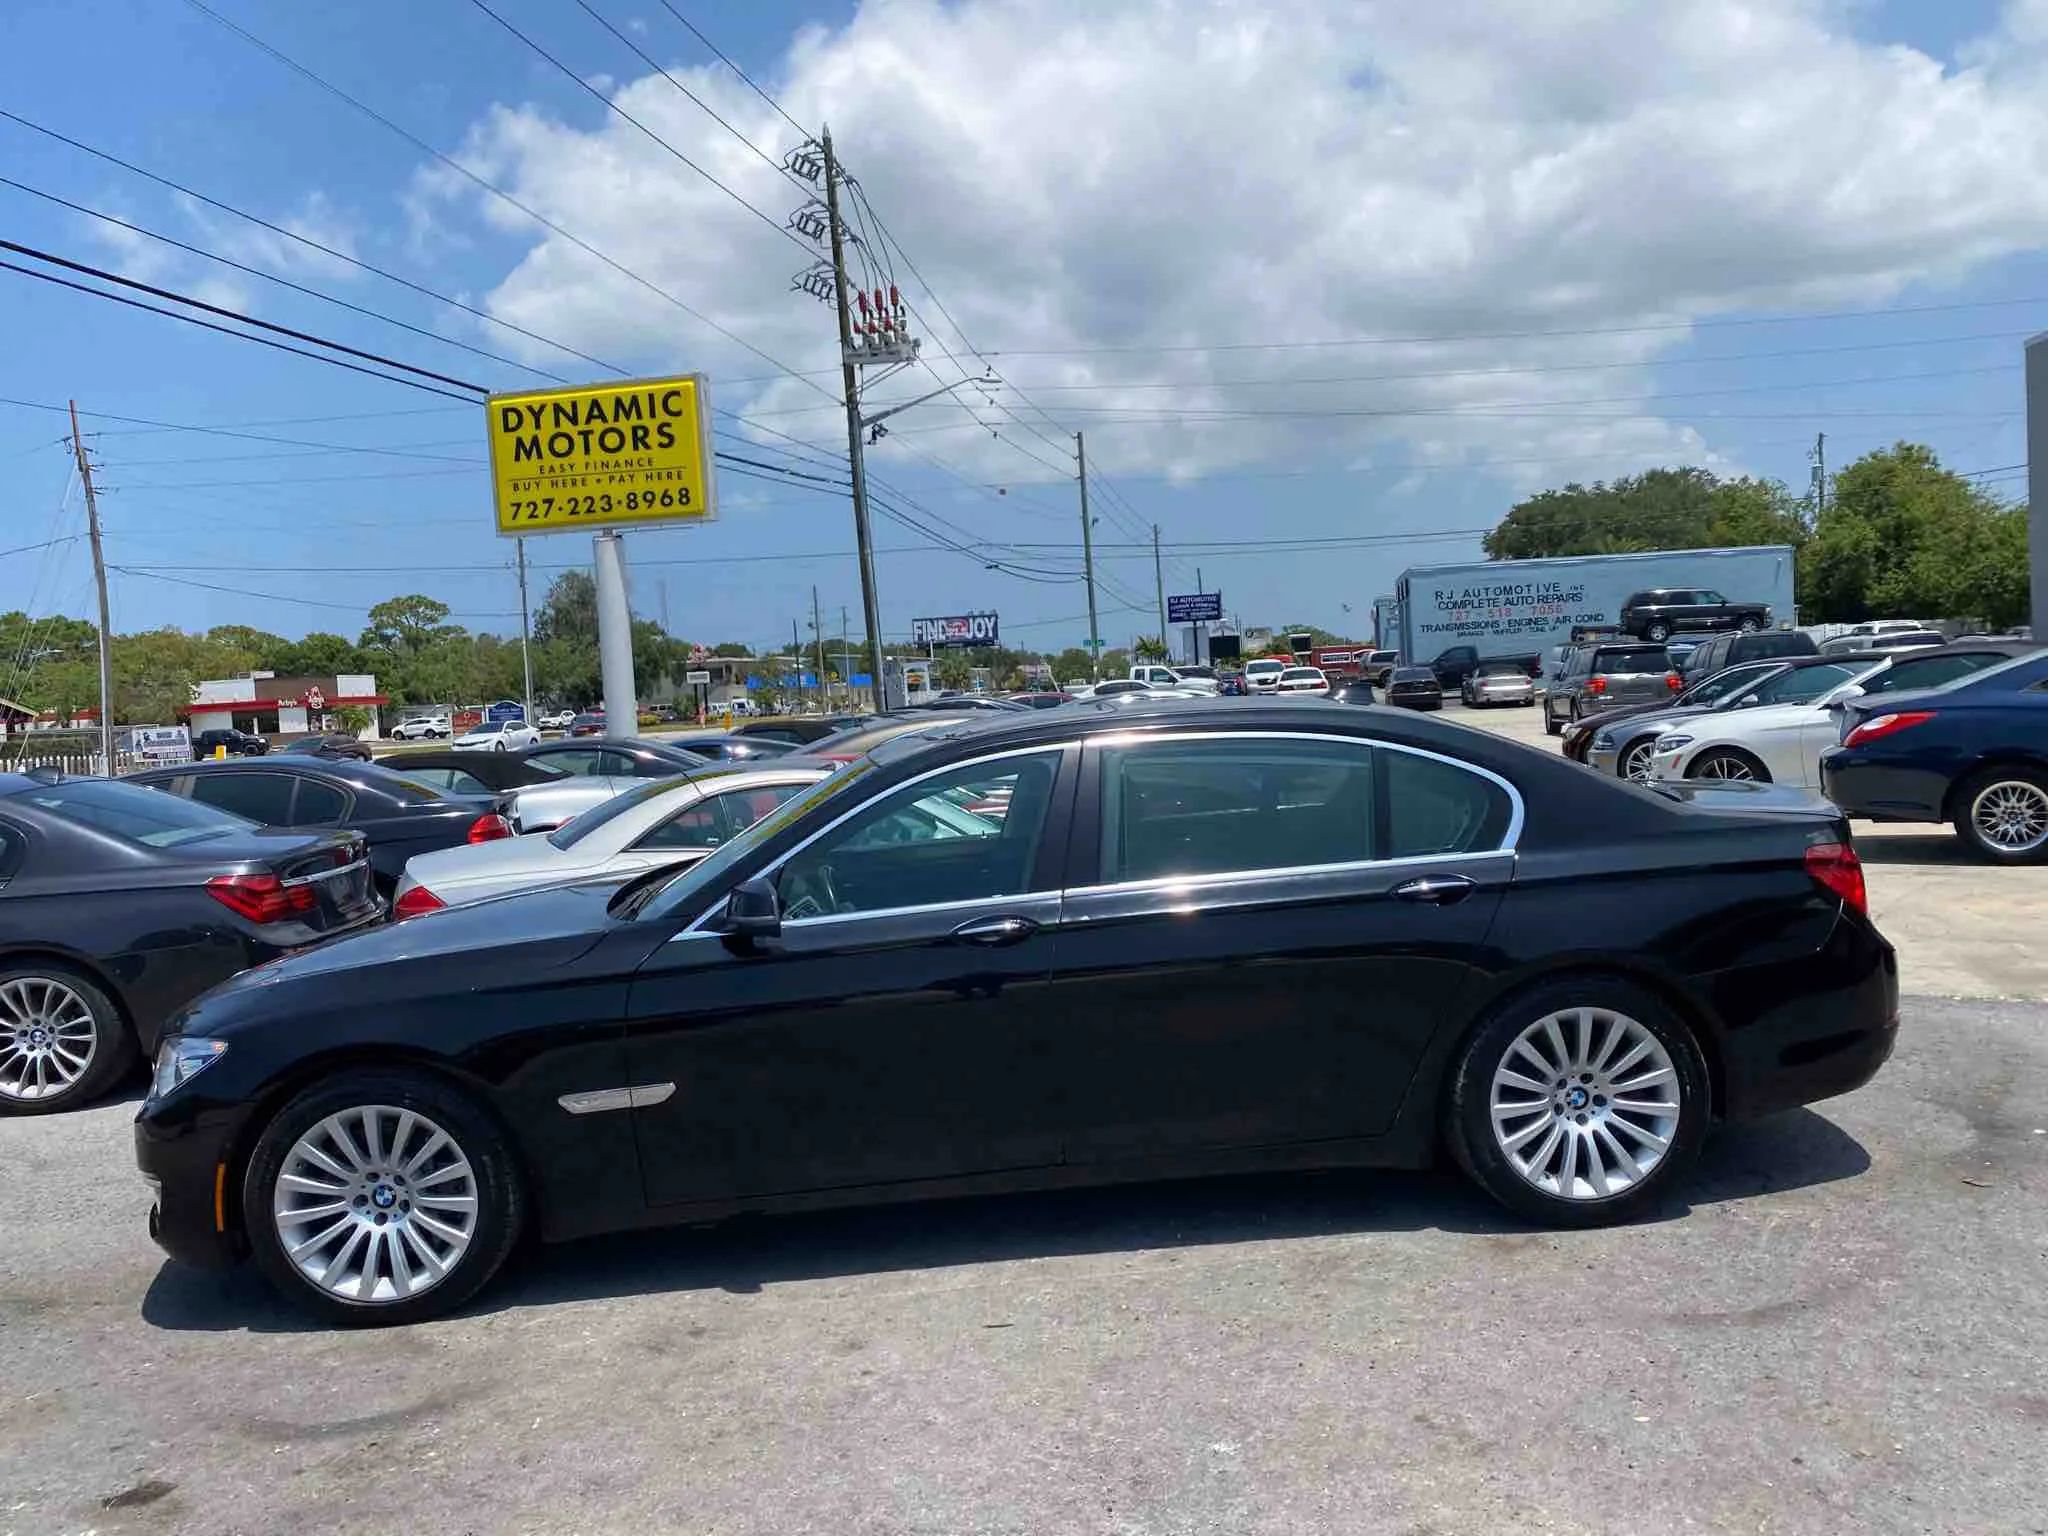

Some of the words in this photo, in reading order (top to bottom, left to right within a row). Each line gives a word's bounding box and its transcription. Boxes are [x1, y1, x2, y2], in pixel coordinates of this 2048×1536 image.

[502, 390, 683, 433] DYNAMIC
[514, 422, 675, 462] MOTORS
[539, 463, 577, 475] EASY
[585, 457, 654, 472] FINANCE
[513, 481, 541, 492] BUY
[550, 477, 588, 489] HERE
[608, 473, 635, 485] PAY
[645, 469, 684, 481] HERE
[1463, 582, 1561, 598] AUTOMOTIVE
[1438, 598, 1501, 610] COMPLETE
[1503, 595, 1535, 606] AUTO
[1537, 592, 1583, 604] REPAIRS
[913, 619, 947, 642] FIND
[966, 616, 996, 638] JOY
[1421, 620, 1500, 633] TRANSMISSIONS
[1507, 616, 1549, 627] ENGINES
[1554, 614, 1572, 625] AIR
